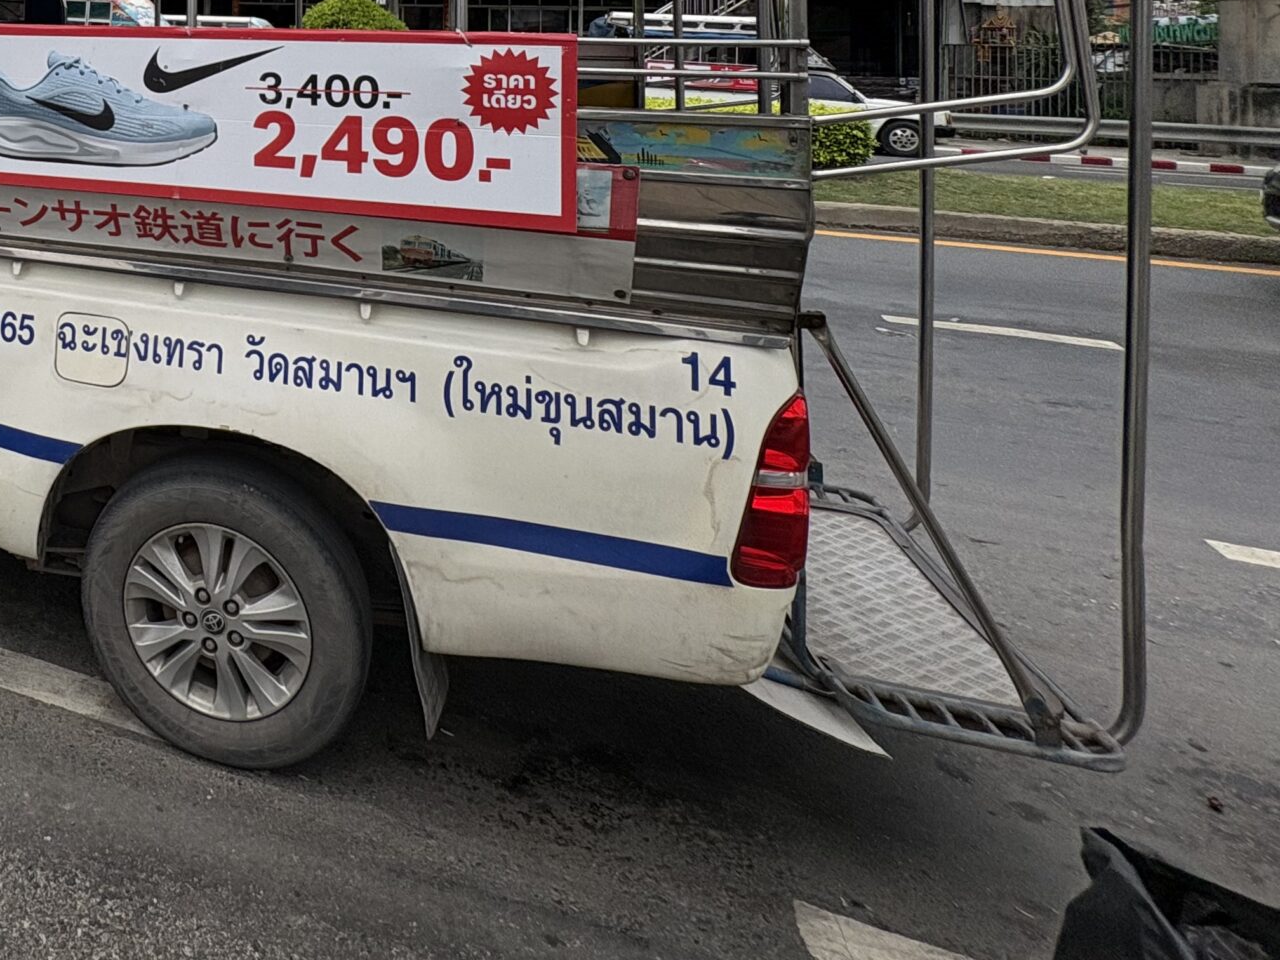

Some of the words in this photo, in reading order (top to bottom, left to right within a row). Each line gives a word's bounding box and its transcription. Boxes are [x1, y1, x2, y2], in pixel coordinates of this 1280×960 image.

[258, 71, 403, 110] 3,400.-
[482, 88, 537, 110] เดียว
[483, 72, 535, 89] ราคา
[253, 110, 512, 183] 2,490.-
[681, 352, 737, 397] 14
[244, 334, 417, 403] วัดสมานฯ
[443, 355, 735, 460] (ใหม่ขุนสมาน)
